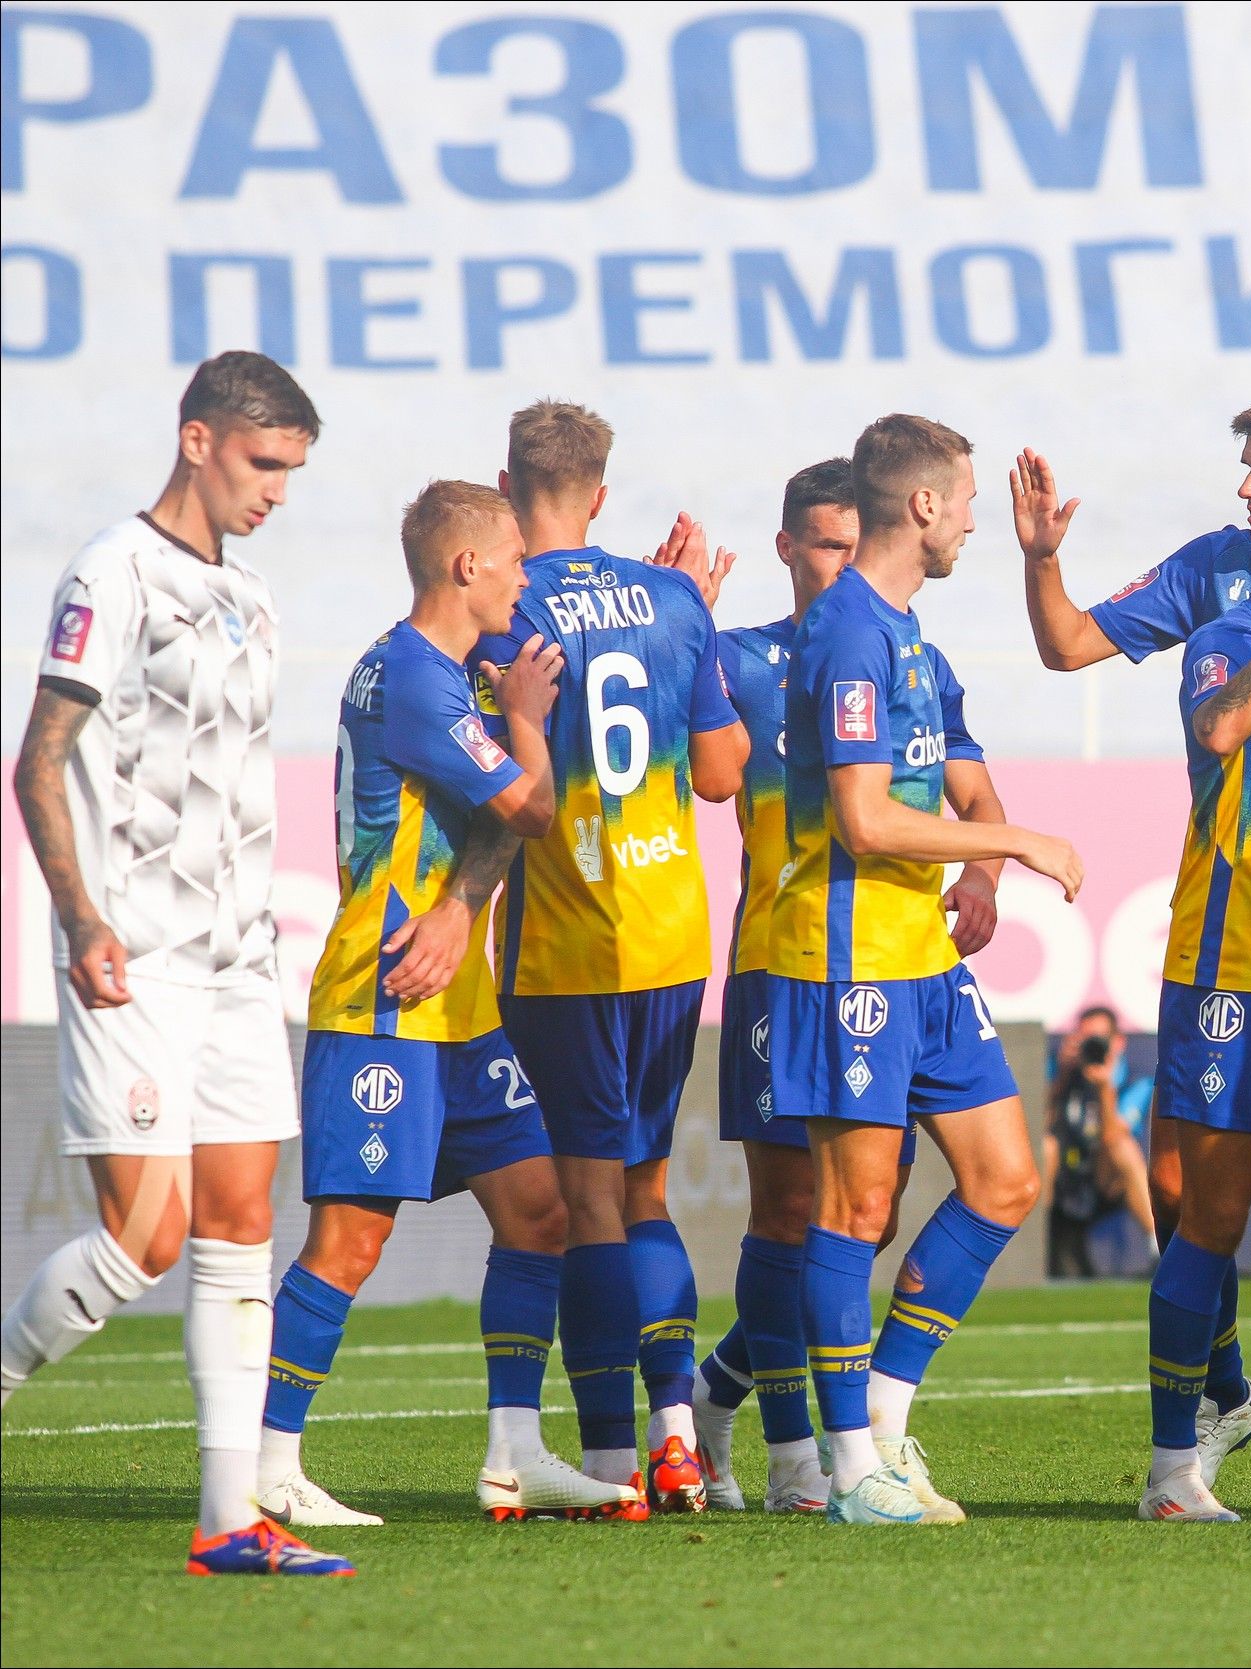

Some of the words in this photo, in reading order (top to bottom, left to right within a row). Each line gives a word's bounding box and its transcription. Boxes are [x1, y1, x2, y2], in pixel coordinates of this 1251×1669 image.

[0, 2, 1206, 207] РАЗОМ
[545, 584, 655, 635] БРАЖКО
[586, 651, 650, 797] 6
[611, 826, 688, 869] vbet
[842, 988, 885, 1034] MG
[1202, 995, 1241, 1038] MG
[356, 1067, 400, 1110] MG
